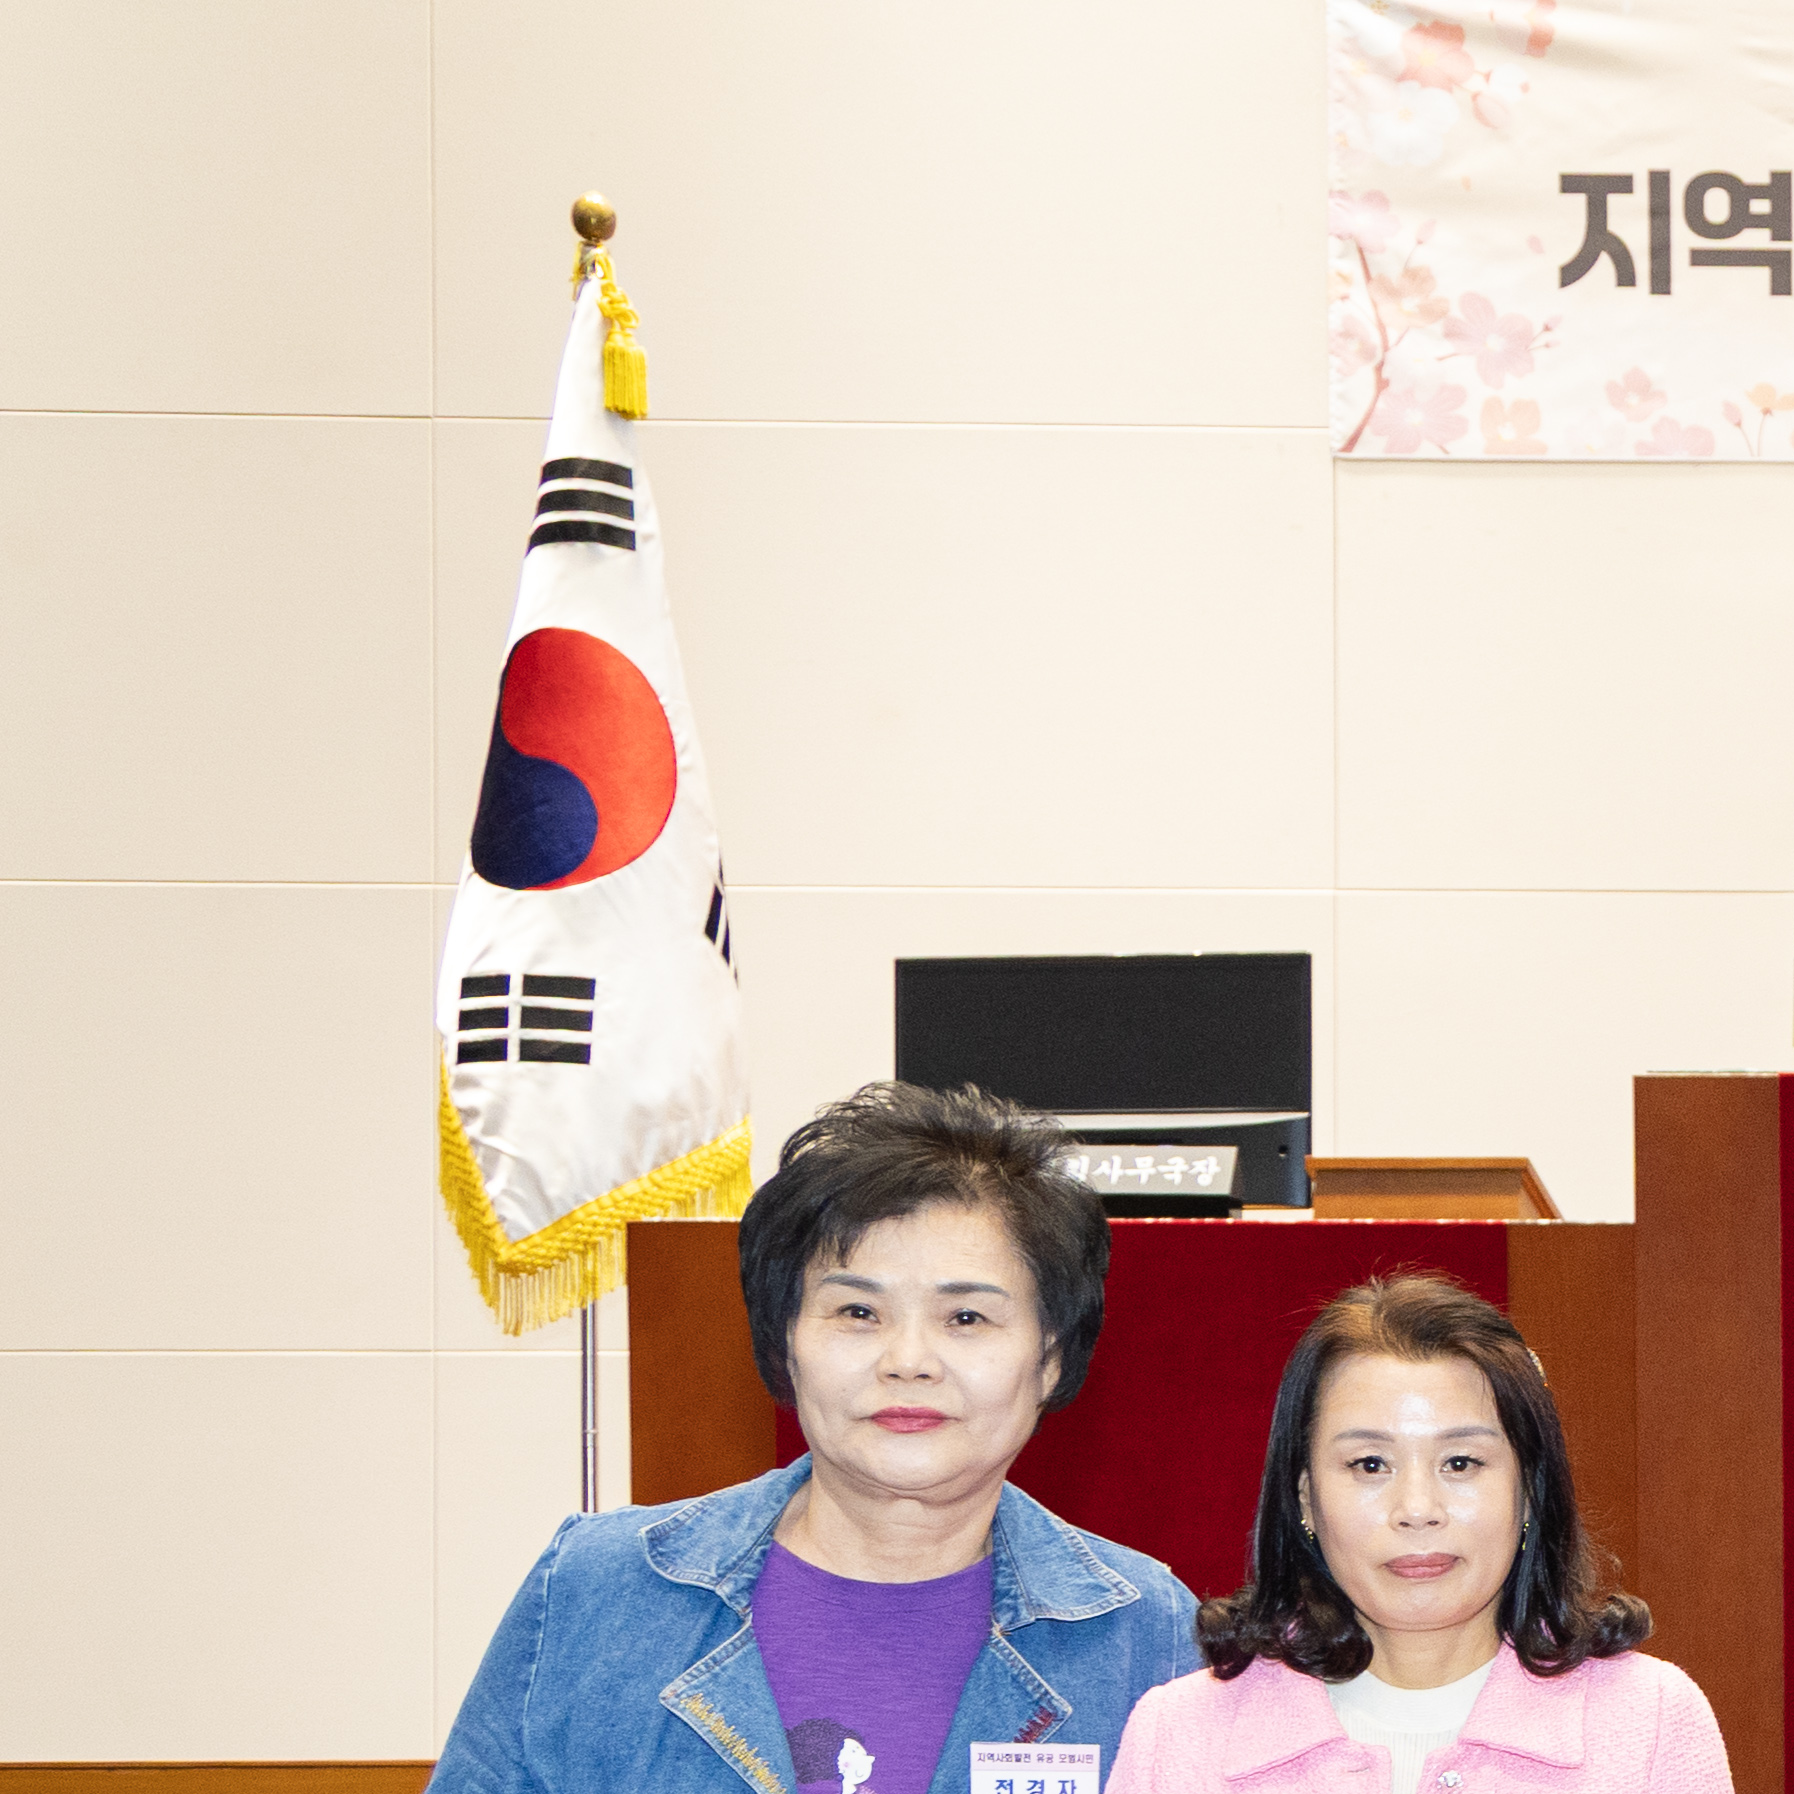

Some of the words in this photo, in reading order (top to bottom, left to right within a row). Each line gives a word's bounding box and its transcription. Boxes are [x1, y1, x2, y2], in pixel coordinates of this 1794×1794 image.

[976, 1752, 1032, 1764] 지역사회발전
[1036, 1753, 1054, 1764] 유공
[1058, 1753, 1094, 1765] 모범시민
